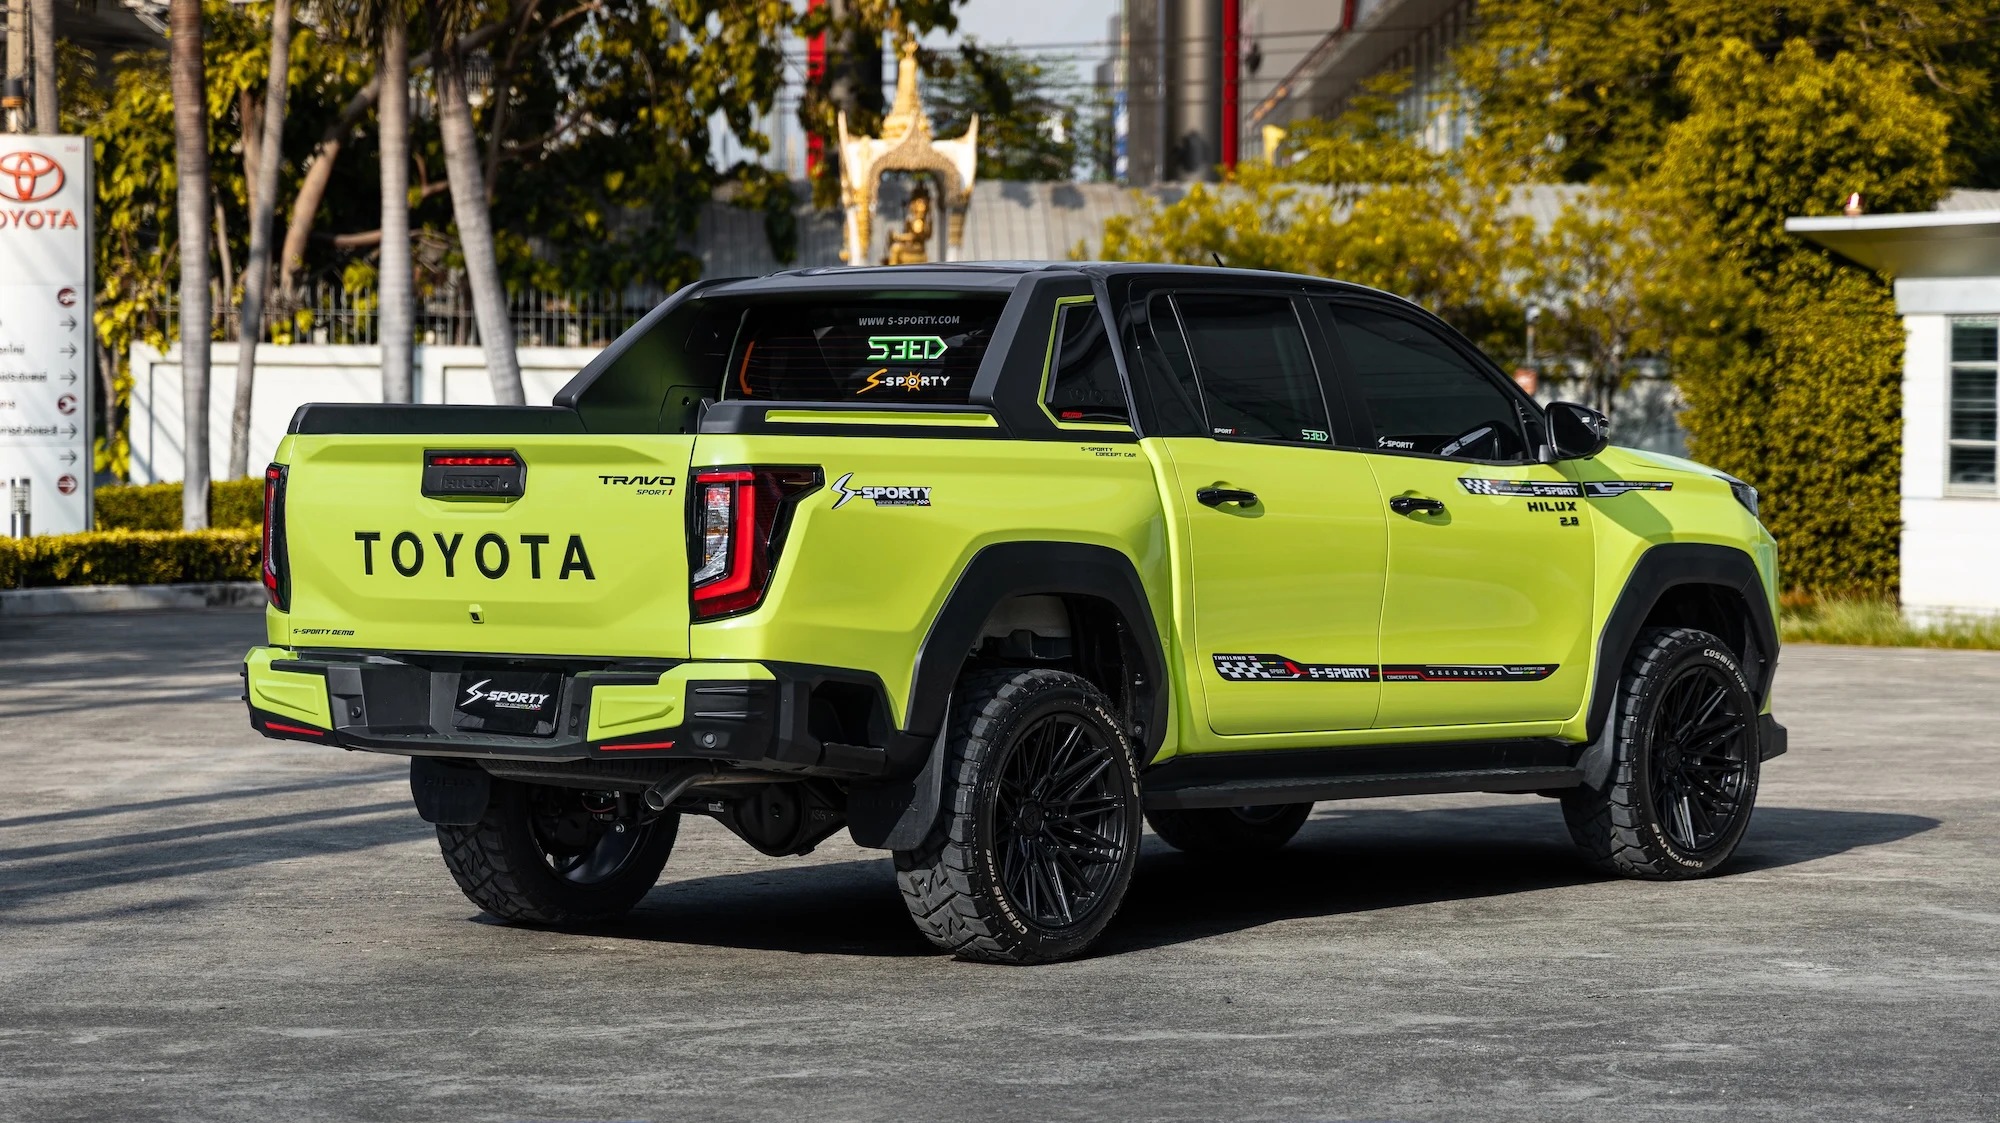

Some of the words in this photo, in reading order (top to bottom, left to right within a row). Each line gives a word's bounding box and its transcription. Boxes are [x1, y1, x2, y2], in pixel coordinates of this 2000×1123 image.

[858, 316, 886, 326] WWW
[887, 315, 961, 326] S-SPORTY.COM
[856, 368, 951, 394] S-SPORTY
[1378, 436, 1415, 449] S-SPORTY
[444, 479, 494, 489] HILUX
[598, 475, 676, 486] TRAVO
[635, 488, 667, 496] SPORT
[830, 472, 932, 510] S-SPORTY
[1532, 486, 1579, 496] S-SPORTY
[1527, 501, 1577, 512] HILUX
[1559, 516, 1580, 527] 2.8
[354, 530, 596, 580] TOYOTA
[1703, 648, 1735, 671] COSMIS
[1309, 667, 1371, 679] S-SPORTY
[459, 678, 550, 706] S-SPORTY
[991, 885, 1029, 935] COSMIS
